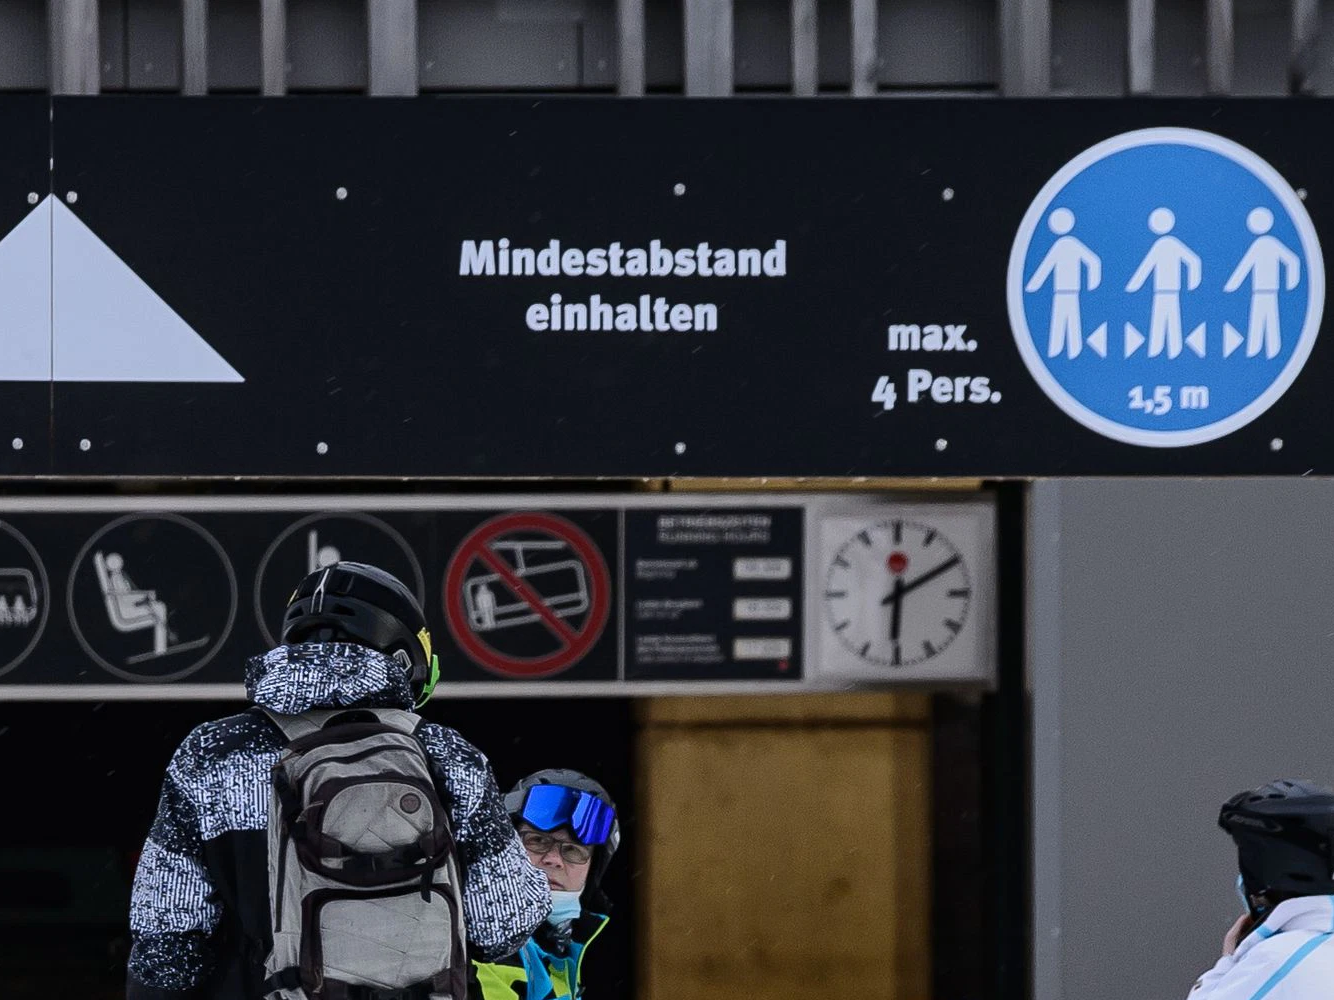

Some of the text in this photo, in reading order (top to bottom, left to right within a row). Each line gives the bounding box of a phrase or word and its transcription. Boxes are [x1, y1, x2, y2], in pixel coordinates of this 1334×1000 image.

[458, 236, 788, 278] Mindestabstand
[525, 292, 719, 333] einhalten
[887, 323, 978, 353] max.
[871, 367, 1003, 411] 4 Pers.
[1128, 384, 1210, 416] 1,5 m
